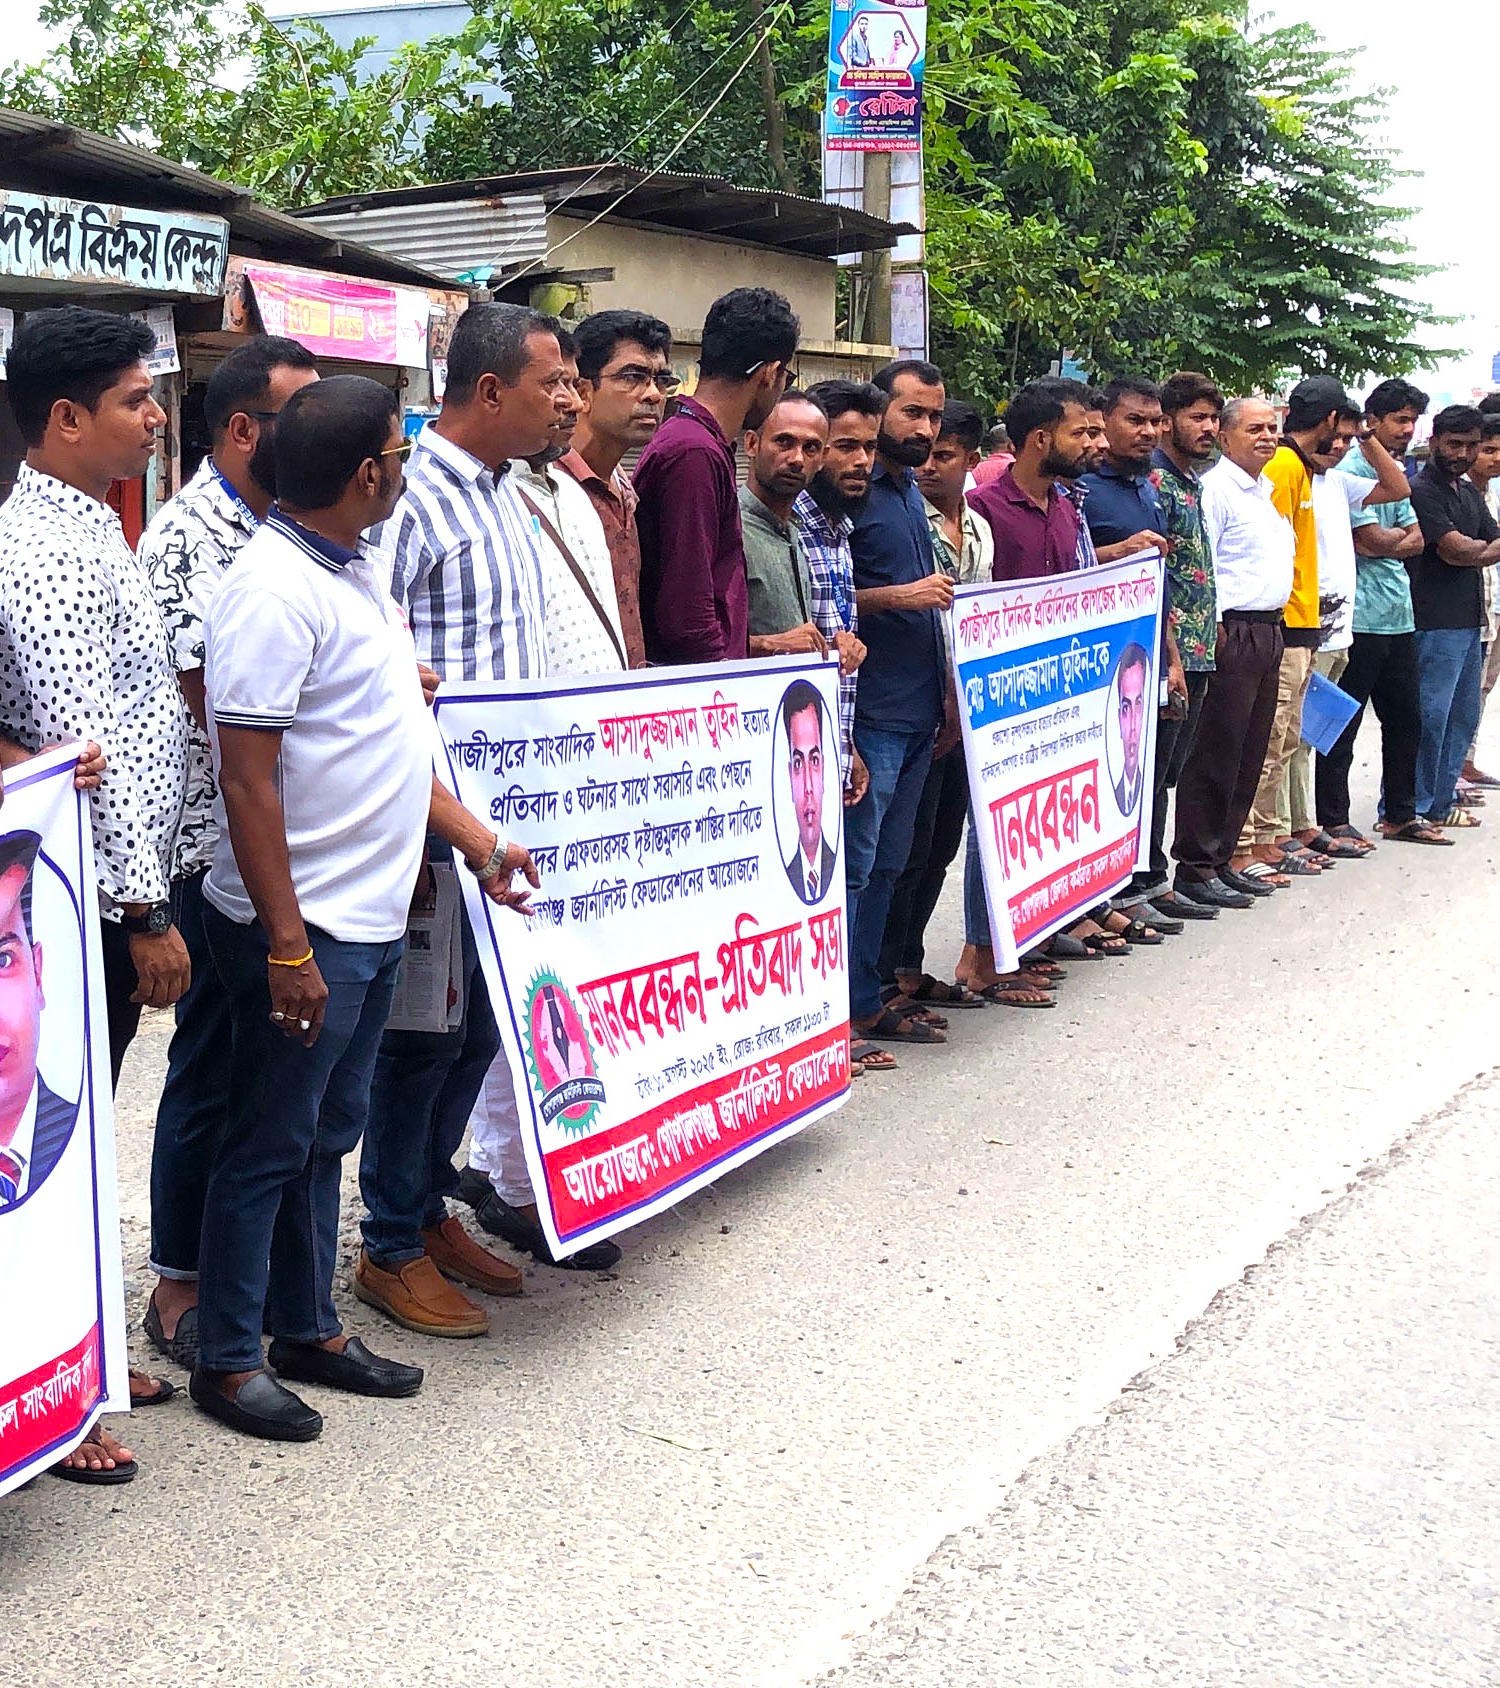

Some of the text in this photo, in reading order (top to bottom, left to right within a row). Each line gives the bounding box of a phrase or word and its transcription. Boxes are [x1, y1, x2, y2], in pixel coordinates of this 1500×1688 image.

[859, 91, 918, 117] রেটিনা
[78, 204, 160, 280] বিক্রয়
[164, 226, 223, 285] কেন্দ্র
[959, 568, 1156, 648] গাজীপুরে দৈনিক প্রতিদিনের কাগজের সাংবাদিক
[987, 653, 1060, 710] আসাদুজ্জামান
[533, 723, 596, 768] সাংবাদিক
[598, 704, 700, 763] আসাদুজ্জামান
[700, 690, 741, 752] তুহিন
[741, 707, 770, 736] হত্যার
[489, 760, 752, 827] প্রতিবাদ ও ঘটনার সাথে সরাসরি এবং পেছনে
[988, 758, 1101, 883] ানববন্ধন
[564, 833, 631, 872] গ্রেফতারসহ
[695, 806, 725, 844] শাস্তির
[728, 800, 763, 839] দাবিতে
[571, 875, 628, 923] জার্নালিস্ট
[632, 867, 704, 911] ফেডারেশনের
[707, 855, 759, 894] আয়োজনে
[808, 907, 844, 980] সভা
[690, 1054, 715, 1077] ২০২৫
[657, 1099, 720, 1168] গোপালগঞ্জ
[716, 1062, 782, 1131] জার্নালিস্ট
[785, 1039, 846, 1101] ফেডারেশন
[20, 1360, 81, 1420] সাংবাদিক
